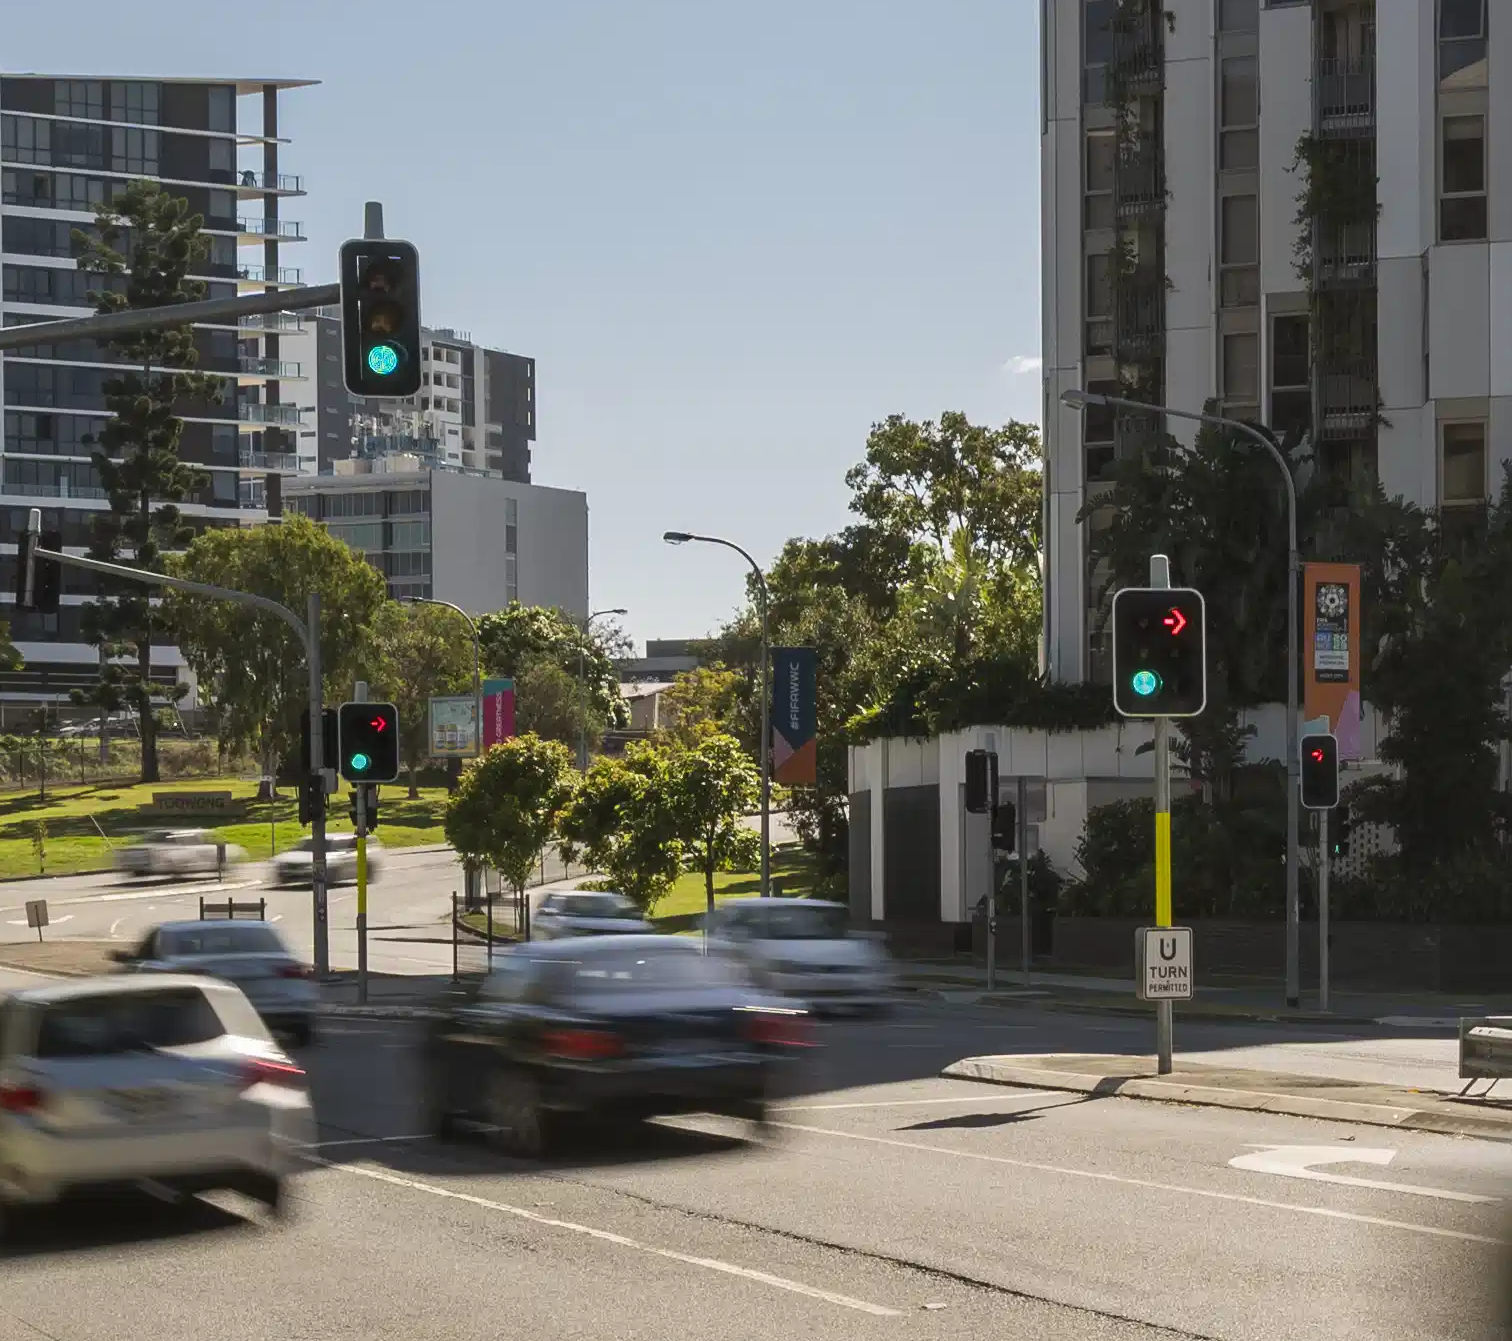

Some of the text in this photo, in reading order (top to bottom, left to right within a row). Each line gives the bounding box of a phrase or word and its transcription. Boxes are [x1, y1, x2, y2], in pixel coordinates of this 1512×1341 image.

[790, 662, 800, 730] #FIFAWWC
[1160, 938, 1176, 961] U
[1149, 965, 1188, 979] TURN
[1149, 983, 1188, 993] PERMITTED
